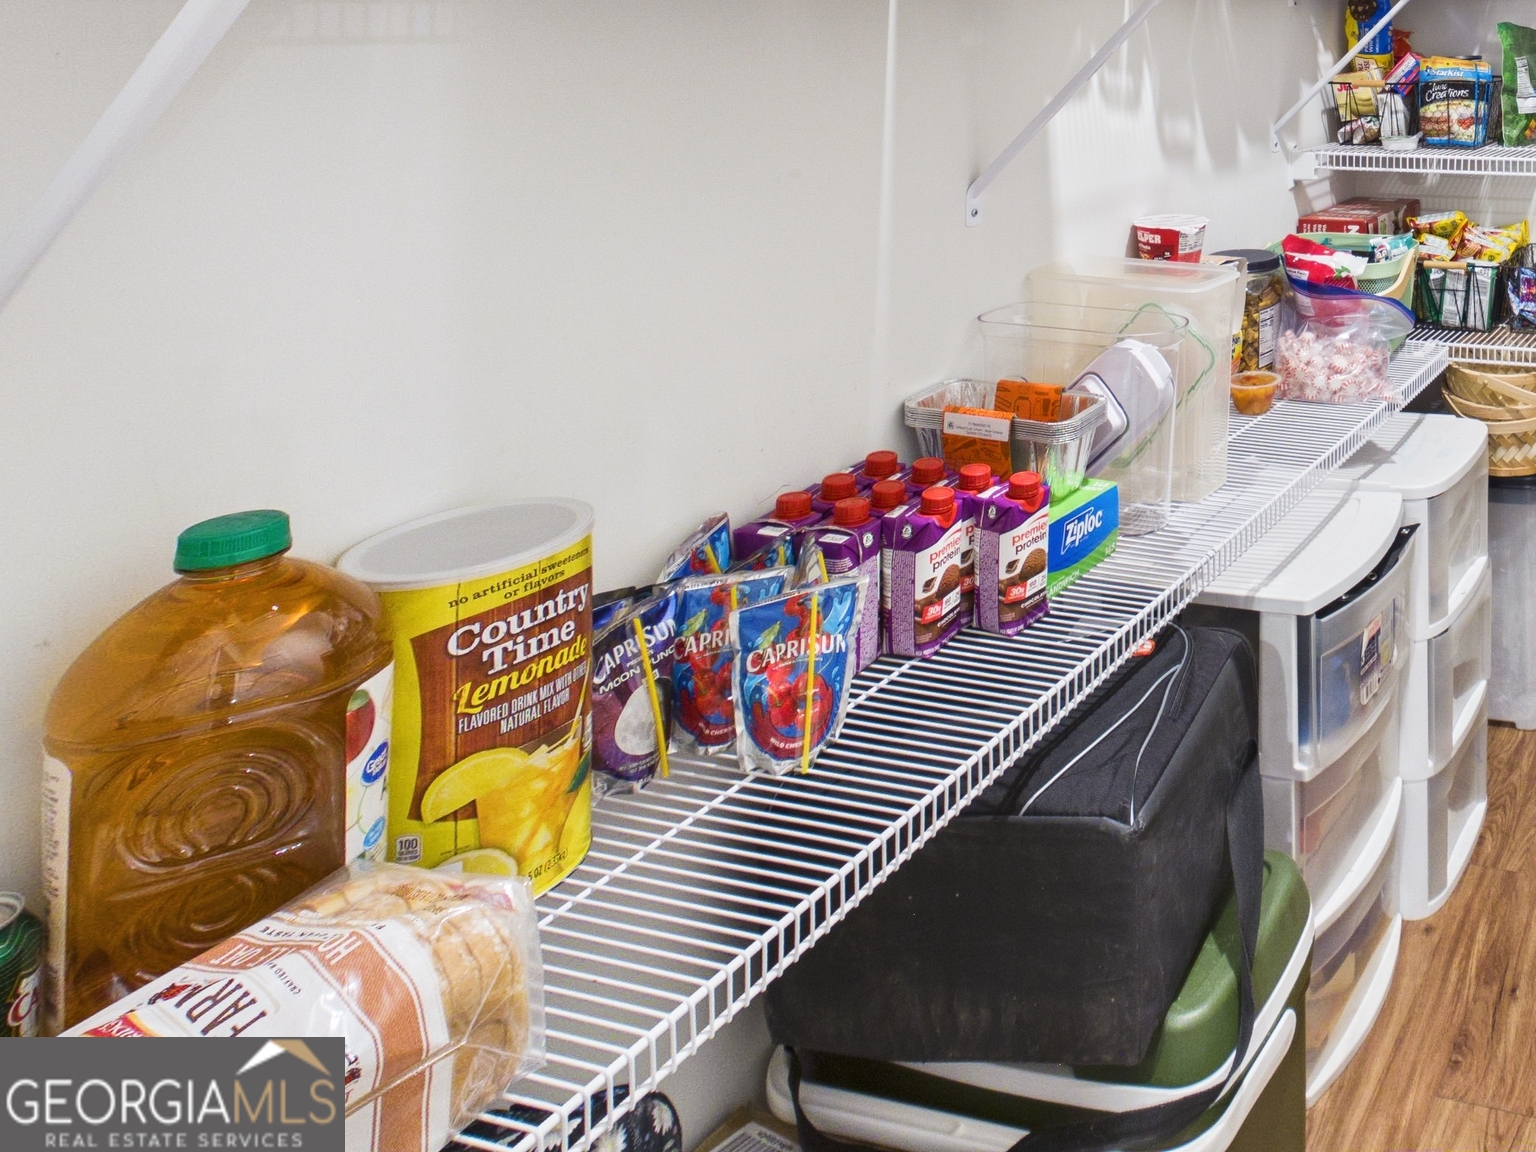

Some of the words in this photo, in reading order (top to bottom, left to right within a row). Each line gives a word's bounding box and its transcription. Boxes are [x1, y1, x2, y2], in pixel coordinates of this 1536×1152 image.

[1432, 69, 1464, 77] StarKist
[1425, 88, 1470, 102] Creations
[1065, 510, 1103, 547] Ziploc
[1015, 531, 1047, 555] protein
[932, 547, 961, 573] protein
[448, 595, 468, 608] no
[472, 569, 538, 600] artificial
[541, 547, 590, 574] sweeteners
[504, 589, 519, 600] or
[523, 570, 566, 591] flavors
[1049, 569, 1080, 596] ANDWICH
[447, 583, 589, 656] Country
[482, 620, 576, 675] Time
[453, 634, 587, 715] Lemonade
[599, 666, 640, 694] MOON
[458, 705, 509, 734] FLAVORED
[511, 692, 538, 714] DRINK
[540, 684, 554, 703] MIX
[555, 671, 572, 693] WITH
[501, 703, 542, 734] NATURAL
[544, 688, 570, 715] FLAVOR
[770, 737, 785, 748] WILD
[398, 838, 418, 851] 100
[273, 967, 302, 995] CRAFTED
